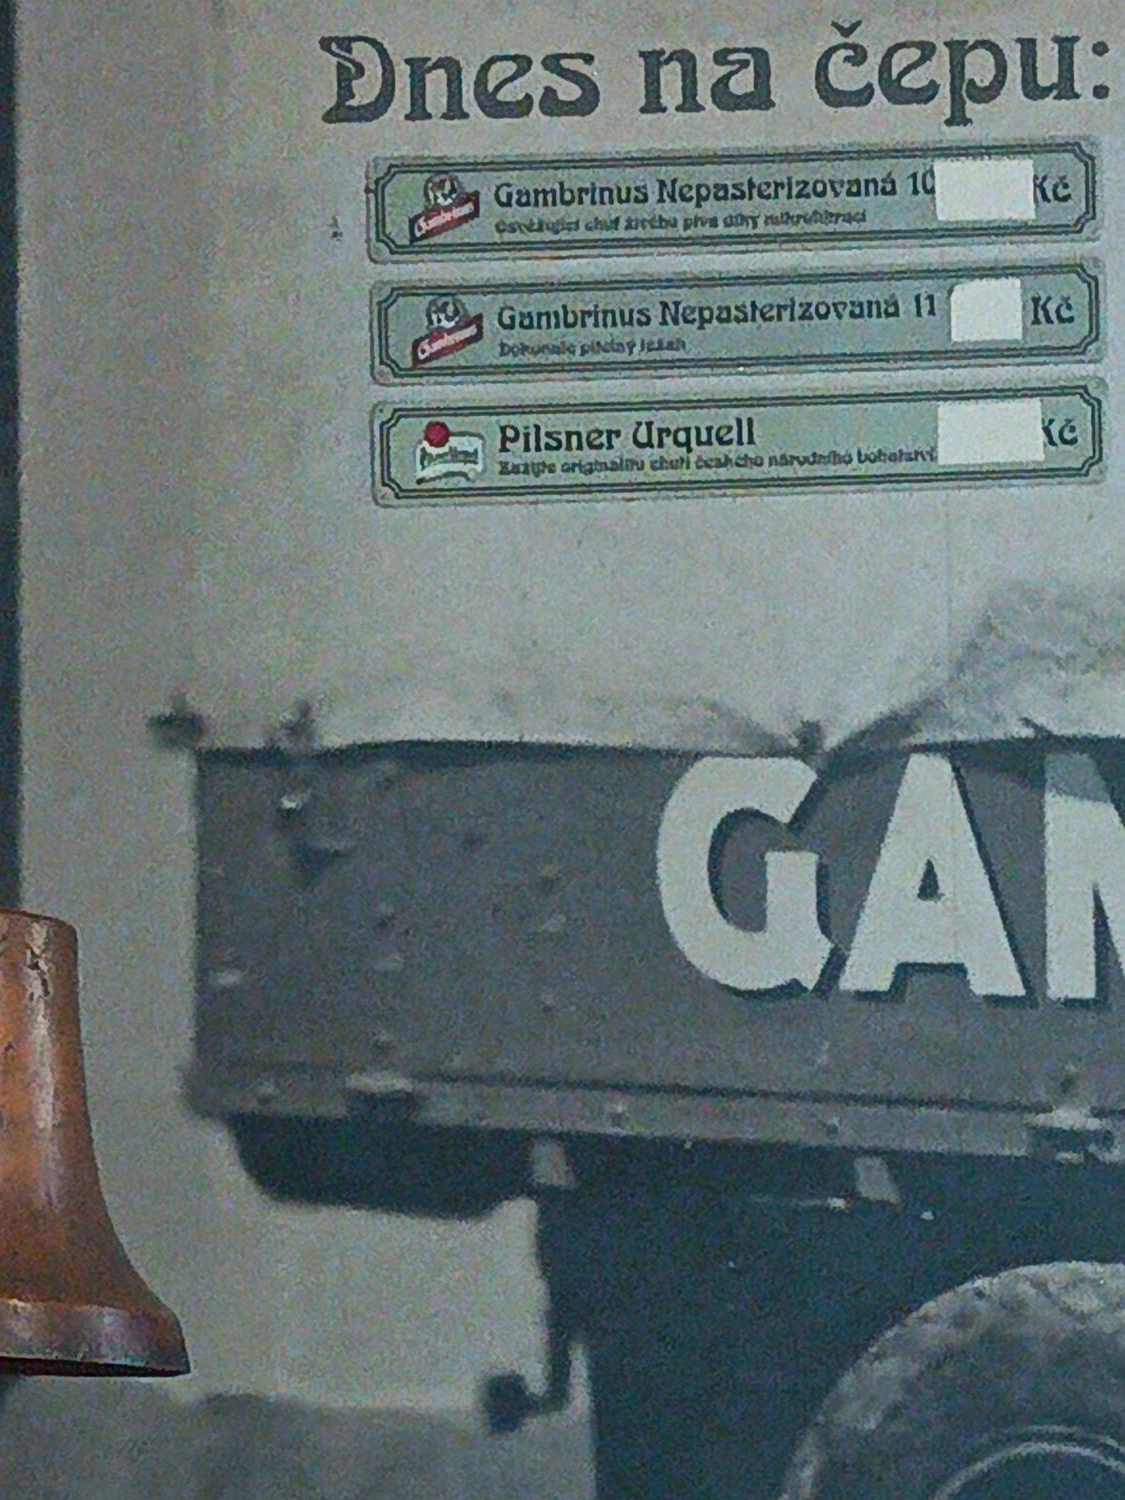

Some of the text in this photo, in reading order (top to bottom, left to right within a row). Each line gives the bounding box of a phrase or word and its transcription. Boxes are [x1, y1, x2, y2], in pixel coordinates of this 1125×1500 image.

[318, 21, 1112, 127] Dnes na čepu:
[493, 180, 649, 208] Gambrinus
[655, 172, 897, 208] Nepasterizovaná
[496, 292, 937, 331] Gambrinus Nepasterizovaná 11
[1030, 294, 1075, 325] Kč
[498, 416, 757, 455] Pilsner Urquell
